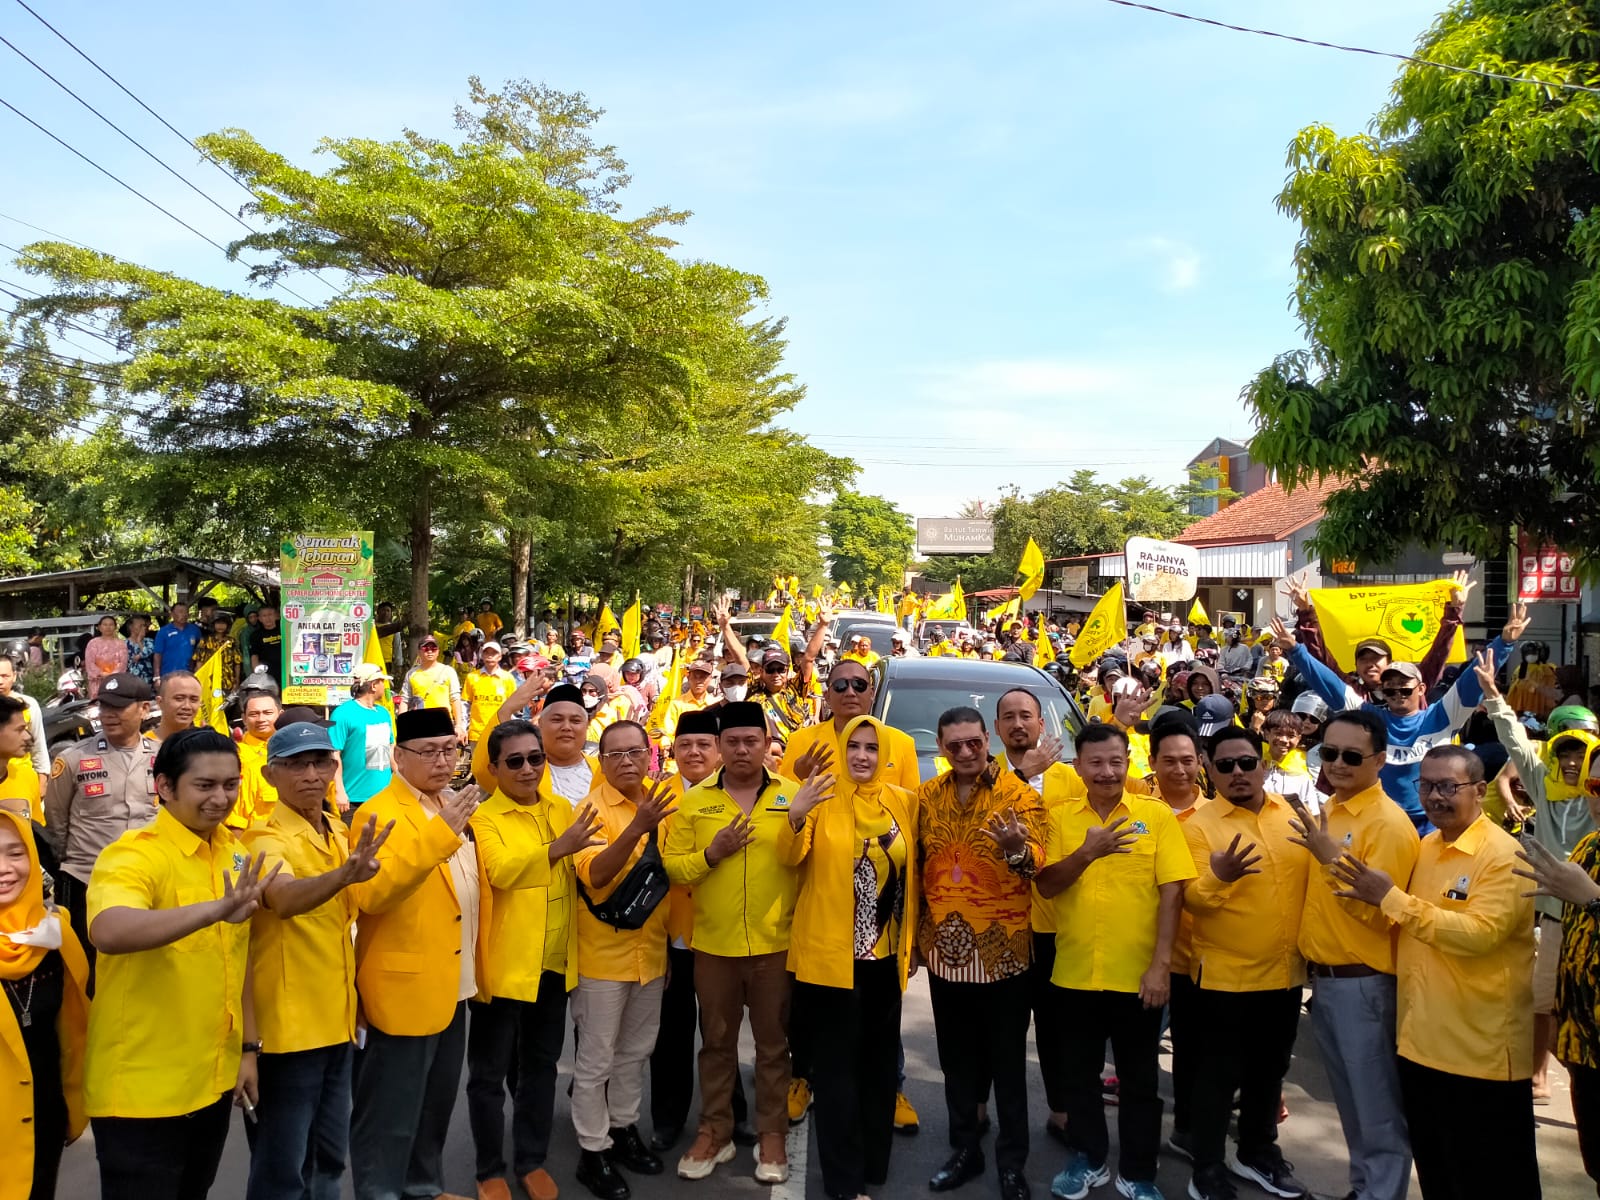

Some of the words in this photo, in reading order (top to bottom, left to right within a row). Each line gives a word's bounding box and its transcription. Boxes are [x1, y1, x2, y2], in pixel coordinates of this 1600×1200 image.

[295, 533, 360, 548] Semarak
[299, 548, 357, 564] Lebaran
[1139, 551, 1186, 567] RAJANYA
[1136, 561, 1154, 571] MIE
[1156, 564, 1189, 577] PEDAS
[297, 622, 321, 630] ANEKA
[323, 622, 336, 630] CAT
